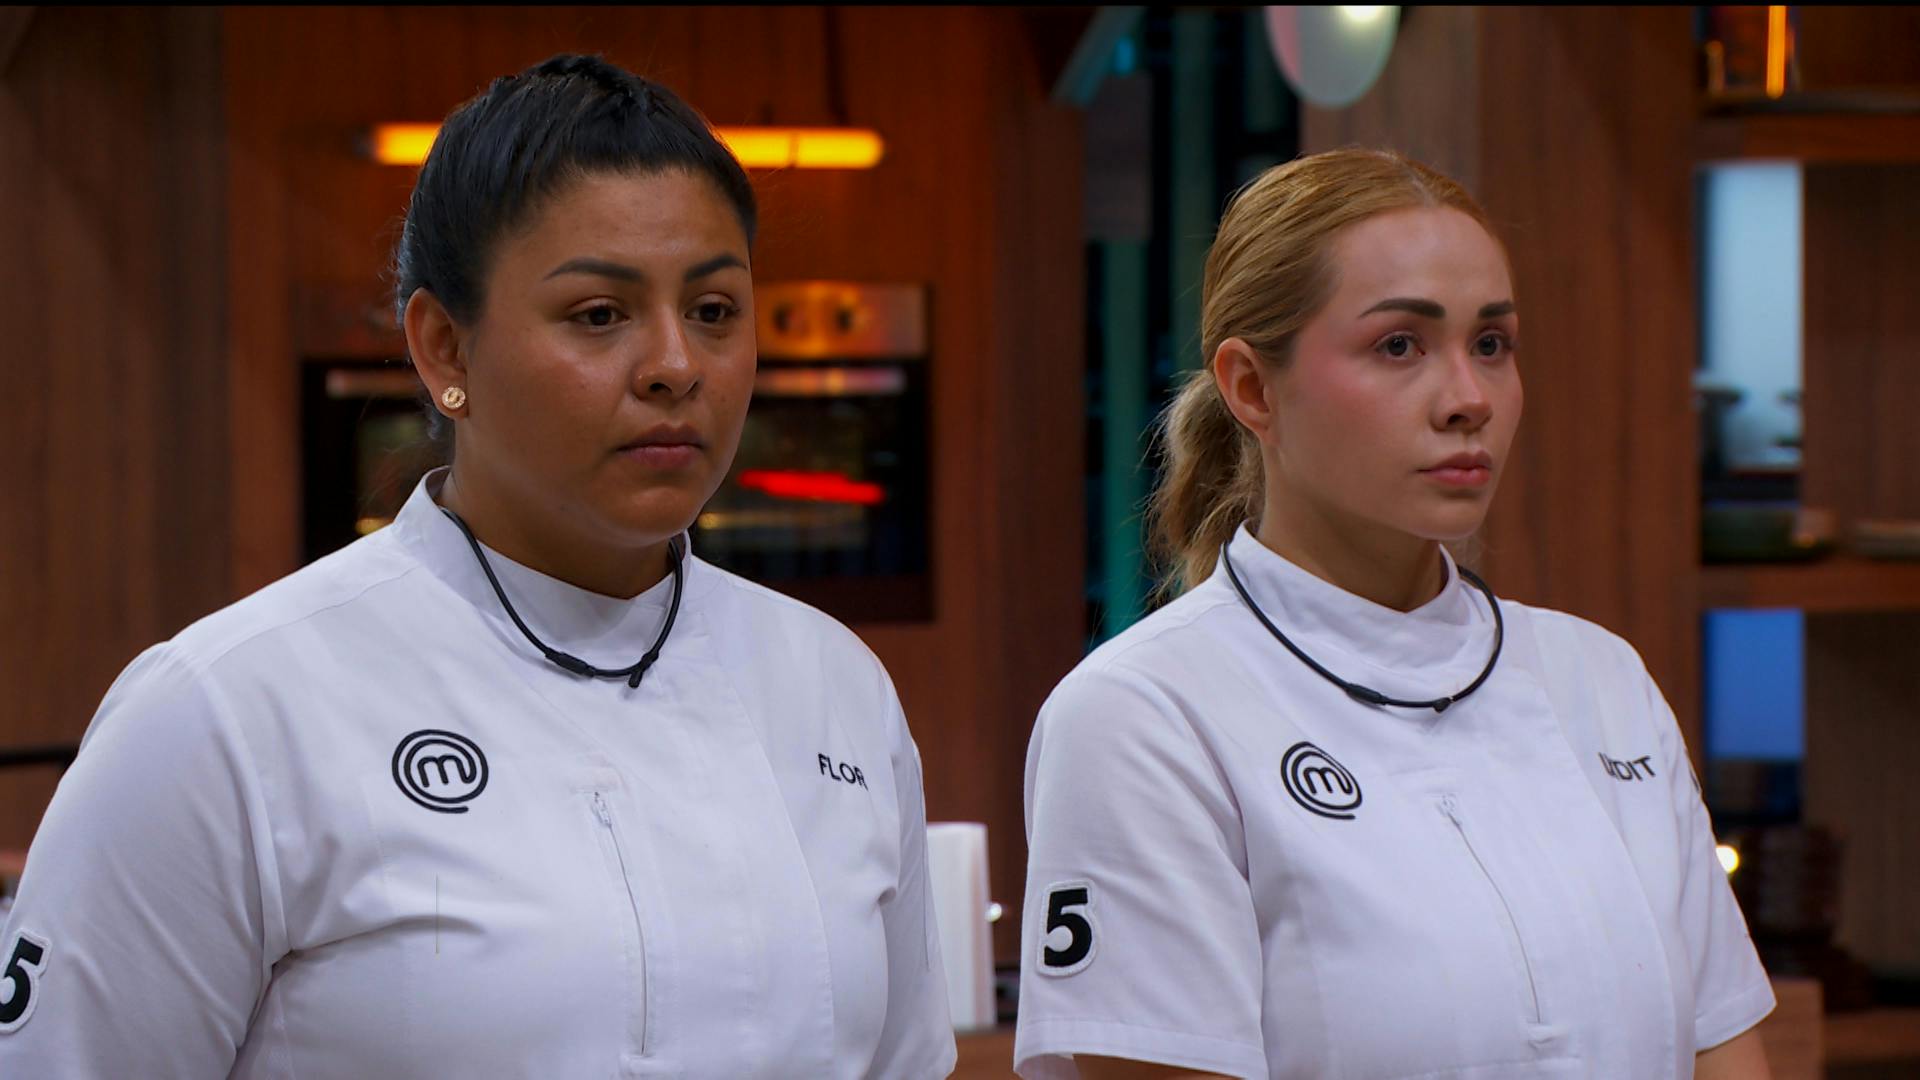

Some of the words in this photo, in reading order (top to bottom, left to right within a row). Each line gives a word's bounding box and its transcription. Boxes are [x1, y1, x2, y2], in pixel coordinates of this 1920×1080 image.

[818, 752, 868, 791] FLOR
[1043, 887, 1092, 968] 5
[0, 936, 44, 1024] 5
